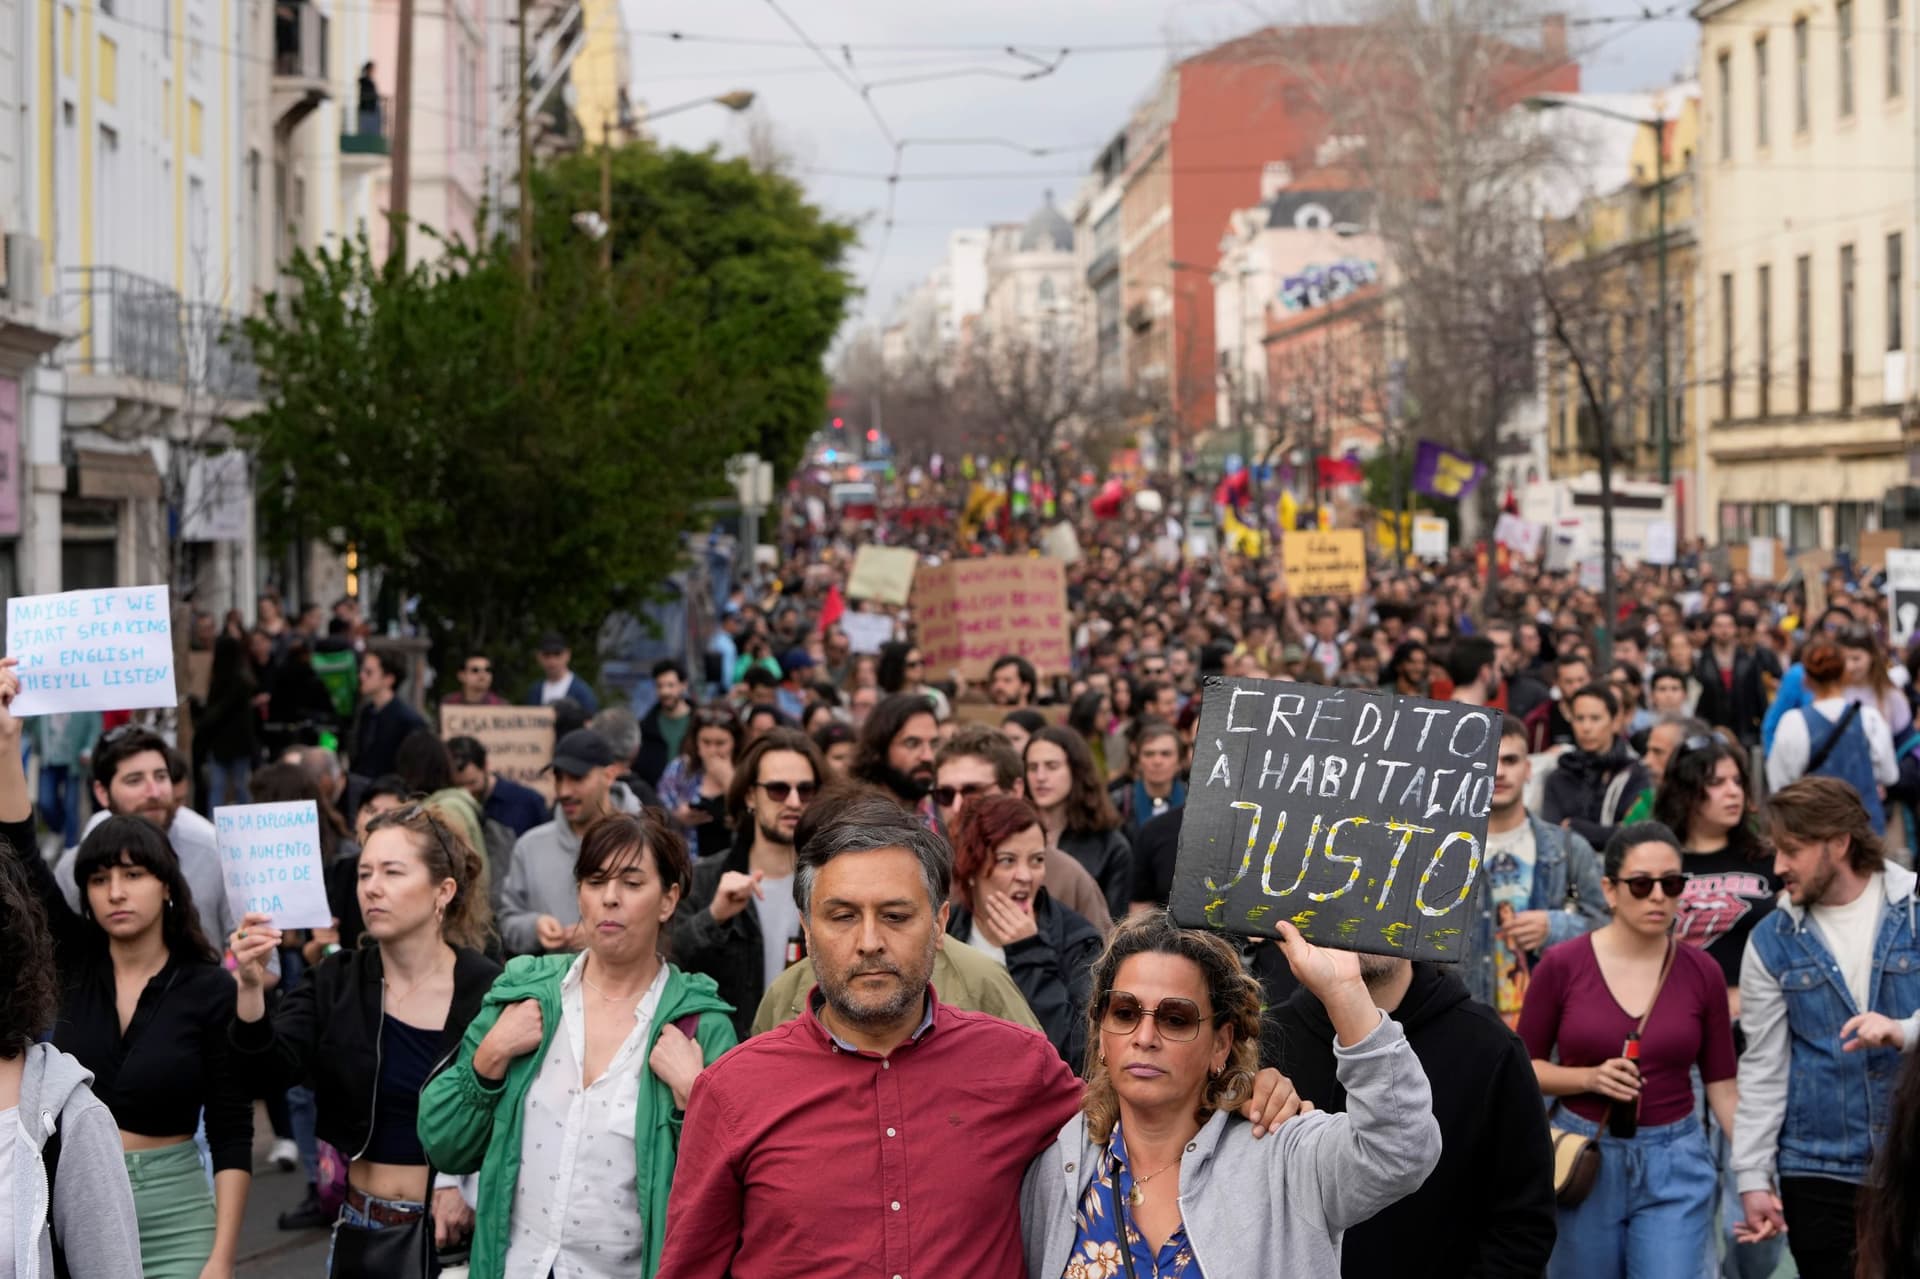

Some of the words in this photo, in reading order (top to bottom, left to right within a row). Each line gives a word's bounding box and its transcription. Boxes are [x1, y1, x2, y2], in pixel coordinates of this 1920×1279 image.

[15, 599, 80, 623] MAYBE
[91, 595, 116, 616] IF
[127, 594, 157, 611] WE
[13, 626, 67, 650] START
[77, 619, 168, 640] SPEAKING
[60, 647, 145, 666] ENGLISH
[17, 674, 91, 690] THEY'LL
[103, 665, 169, 686] LISTEN
[1226, 686, 1491, 759] CRÉDITO
[1205, 738, 1231, 788] À
[1258, 748, 1495, 819] HABITAÇÃO
[239, 815, 253, 830] DA
[249, 841, 312, 860] AUMENTO
[1203, 801, 1481, 917] JUSTO
[292, 864, 311, 881] DE
